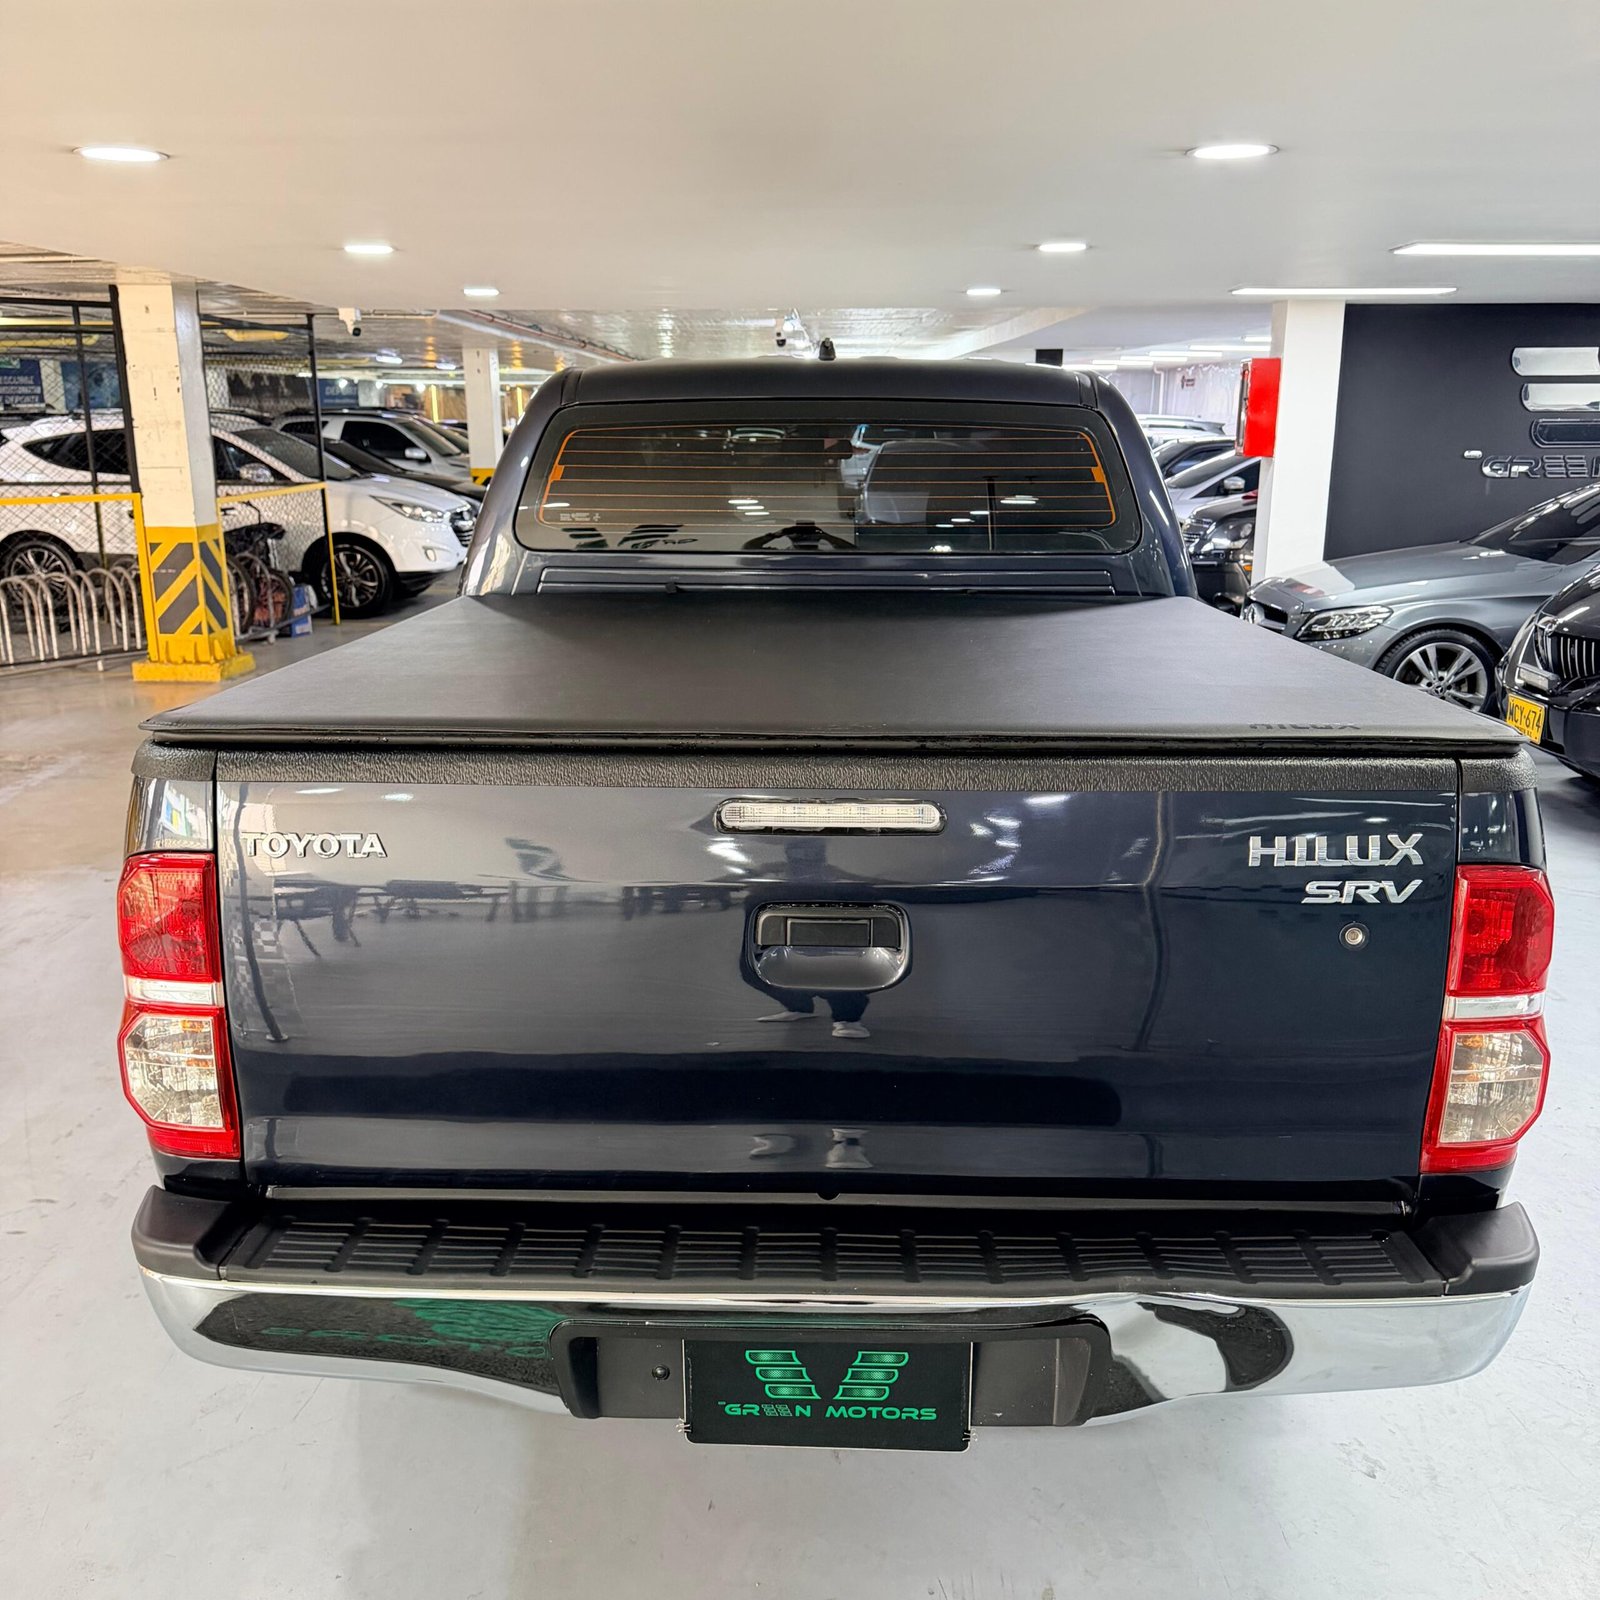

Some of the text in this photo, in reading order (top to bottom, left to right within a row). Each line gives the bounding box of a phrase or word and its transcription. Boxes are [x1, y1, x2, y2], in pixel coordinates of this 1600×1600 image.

[241, 832, 388, 858] TOYOTA
[1249, 833, 1423, 867] HILUX
[1301, 879, 1423, 904] SRV
[724, 1403, 938, 1421] GREEN MOTORS
